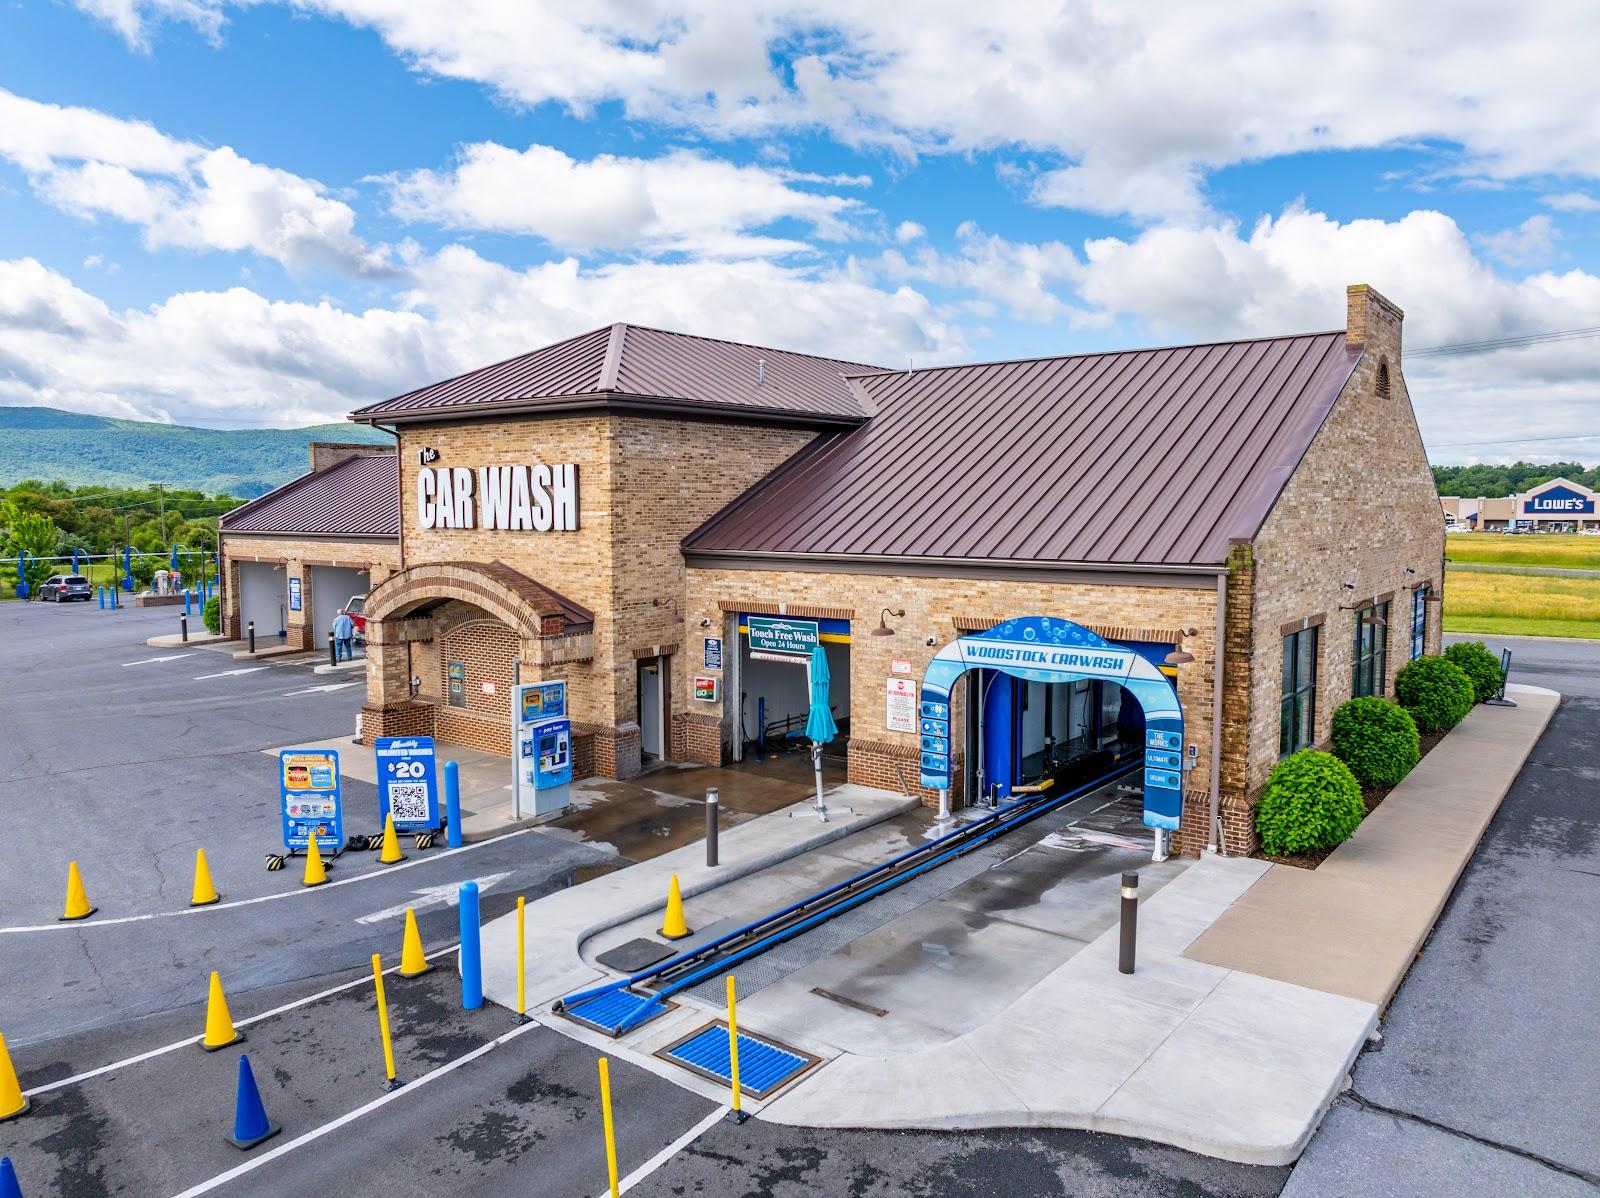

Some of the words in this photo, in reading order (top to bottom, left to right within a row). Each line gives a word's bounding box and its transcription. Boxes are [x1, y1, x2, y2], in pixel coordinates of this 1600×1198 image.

[417, 447, 438, 465] The
[417, 467, 475, 529] CAR
[479, 464, 578, 532] WASH
[1534, 498, 1584, 510] LOWE'S
[750, 627, 774, 638] Touch
[775, 630, 794, 641] Free
[793, 631, 817, 643] Wash
[760, 638, 777, 648] Open
[777, 640, 786, 648] 24
[786, 641, 806, 650] Hours
[966, 645, 1048, 664] WOODSTOCK
[1051, 653, 1124, 671] CARWASH
[696, 689, 707, 697] GO
[1154, 732, 1165, 740] THE
[390, 739, 418, 749] Monthly
[1150, 739, 1169, 747] WORKS
[1147, 754, 1169, 764] ULTIMATE
[387, 761, 426, 778] $20
